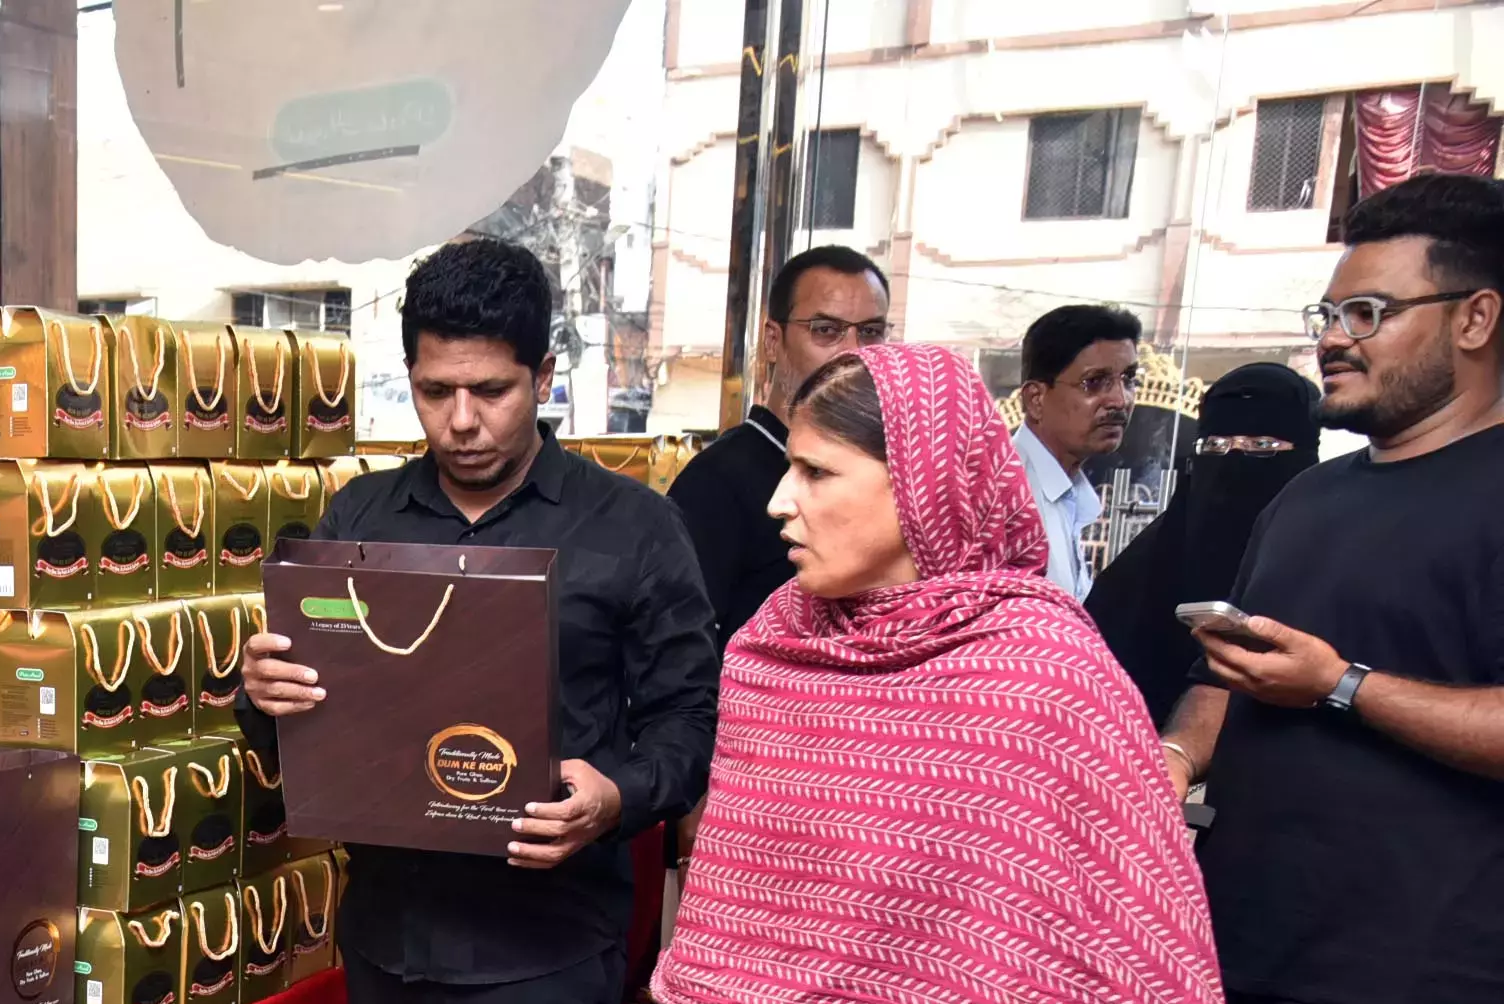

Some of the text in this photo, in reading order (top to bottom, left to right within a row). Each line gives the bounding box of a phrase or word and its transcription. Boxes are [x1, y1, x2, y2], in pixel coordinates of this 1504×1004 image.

[437, 759, 505, 772] DUM KE ROAT
